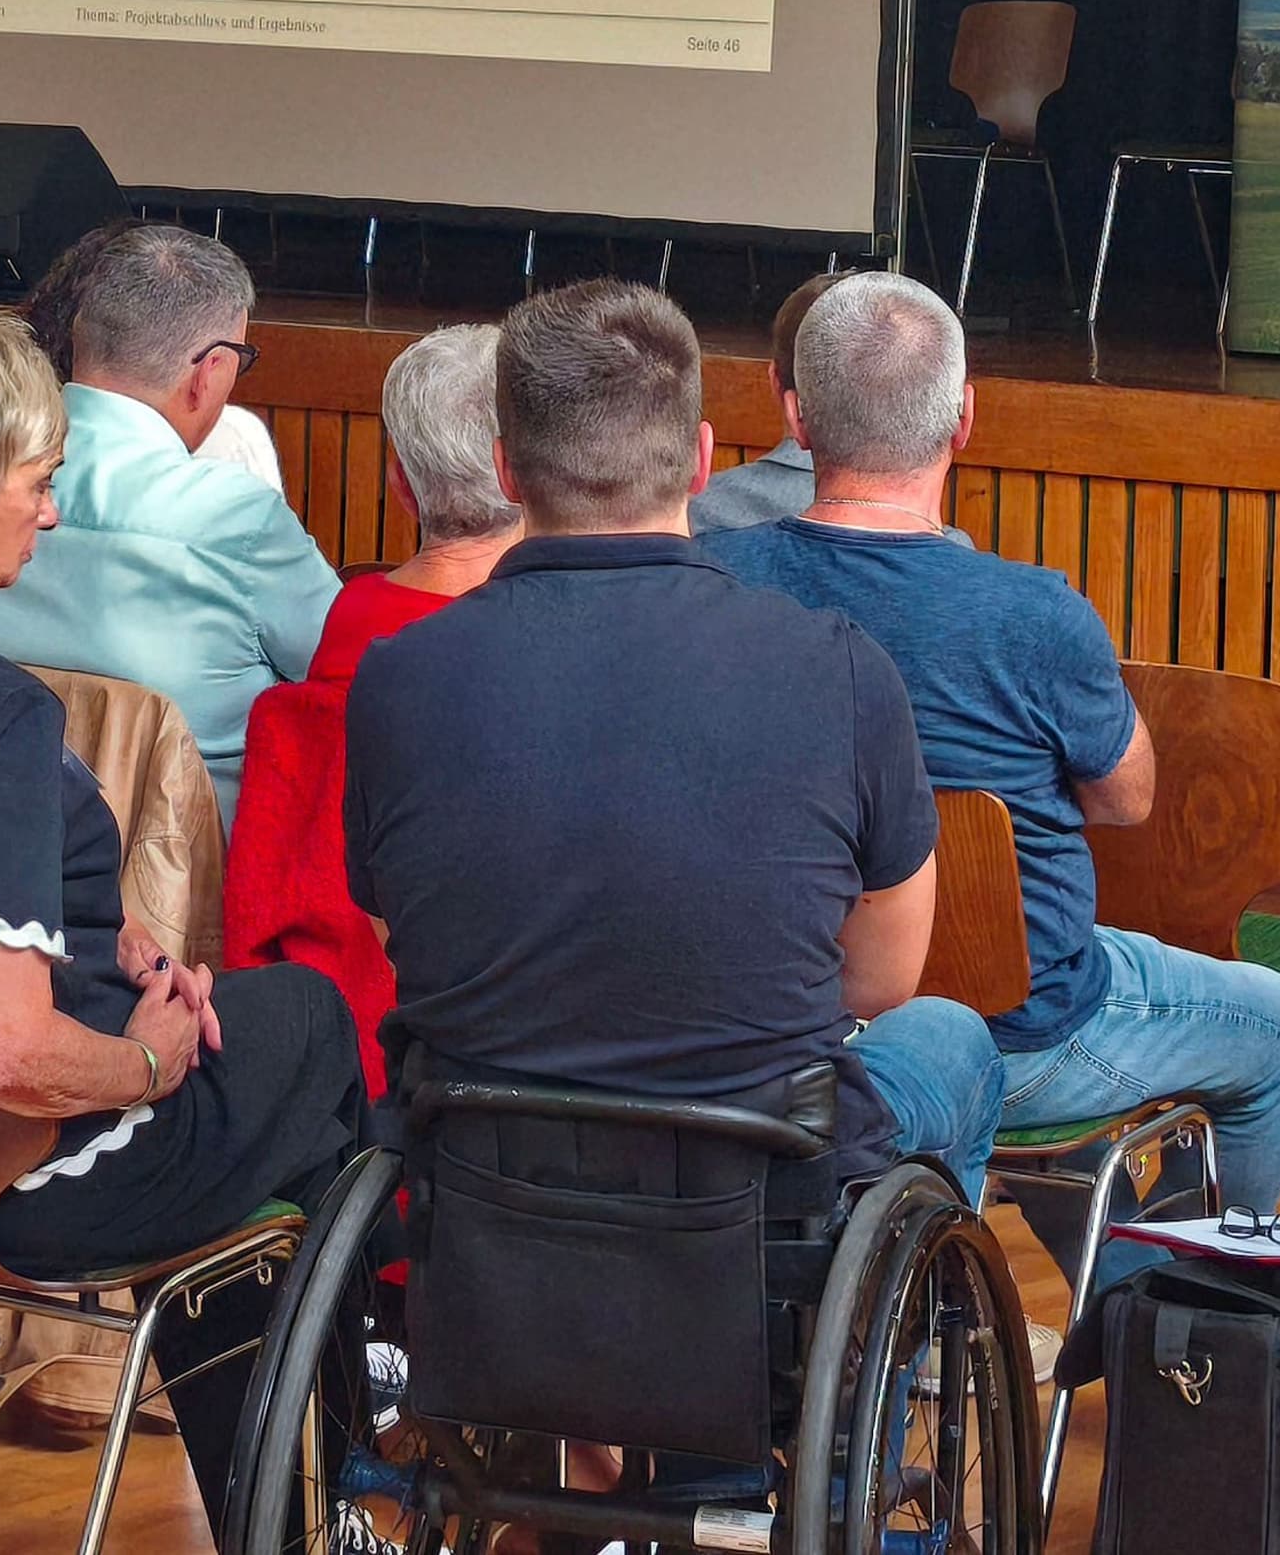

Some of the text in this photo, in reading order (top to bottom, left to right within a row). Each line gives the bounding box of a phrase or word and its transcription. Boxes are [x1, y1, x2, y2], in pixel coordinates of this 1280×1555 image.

[76, 6, 120, 23] Thema:
[231, 14, 256, 31] und
[687, 36, 720, 53] Seite
